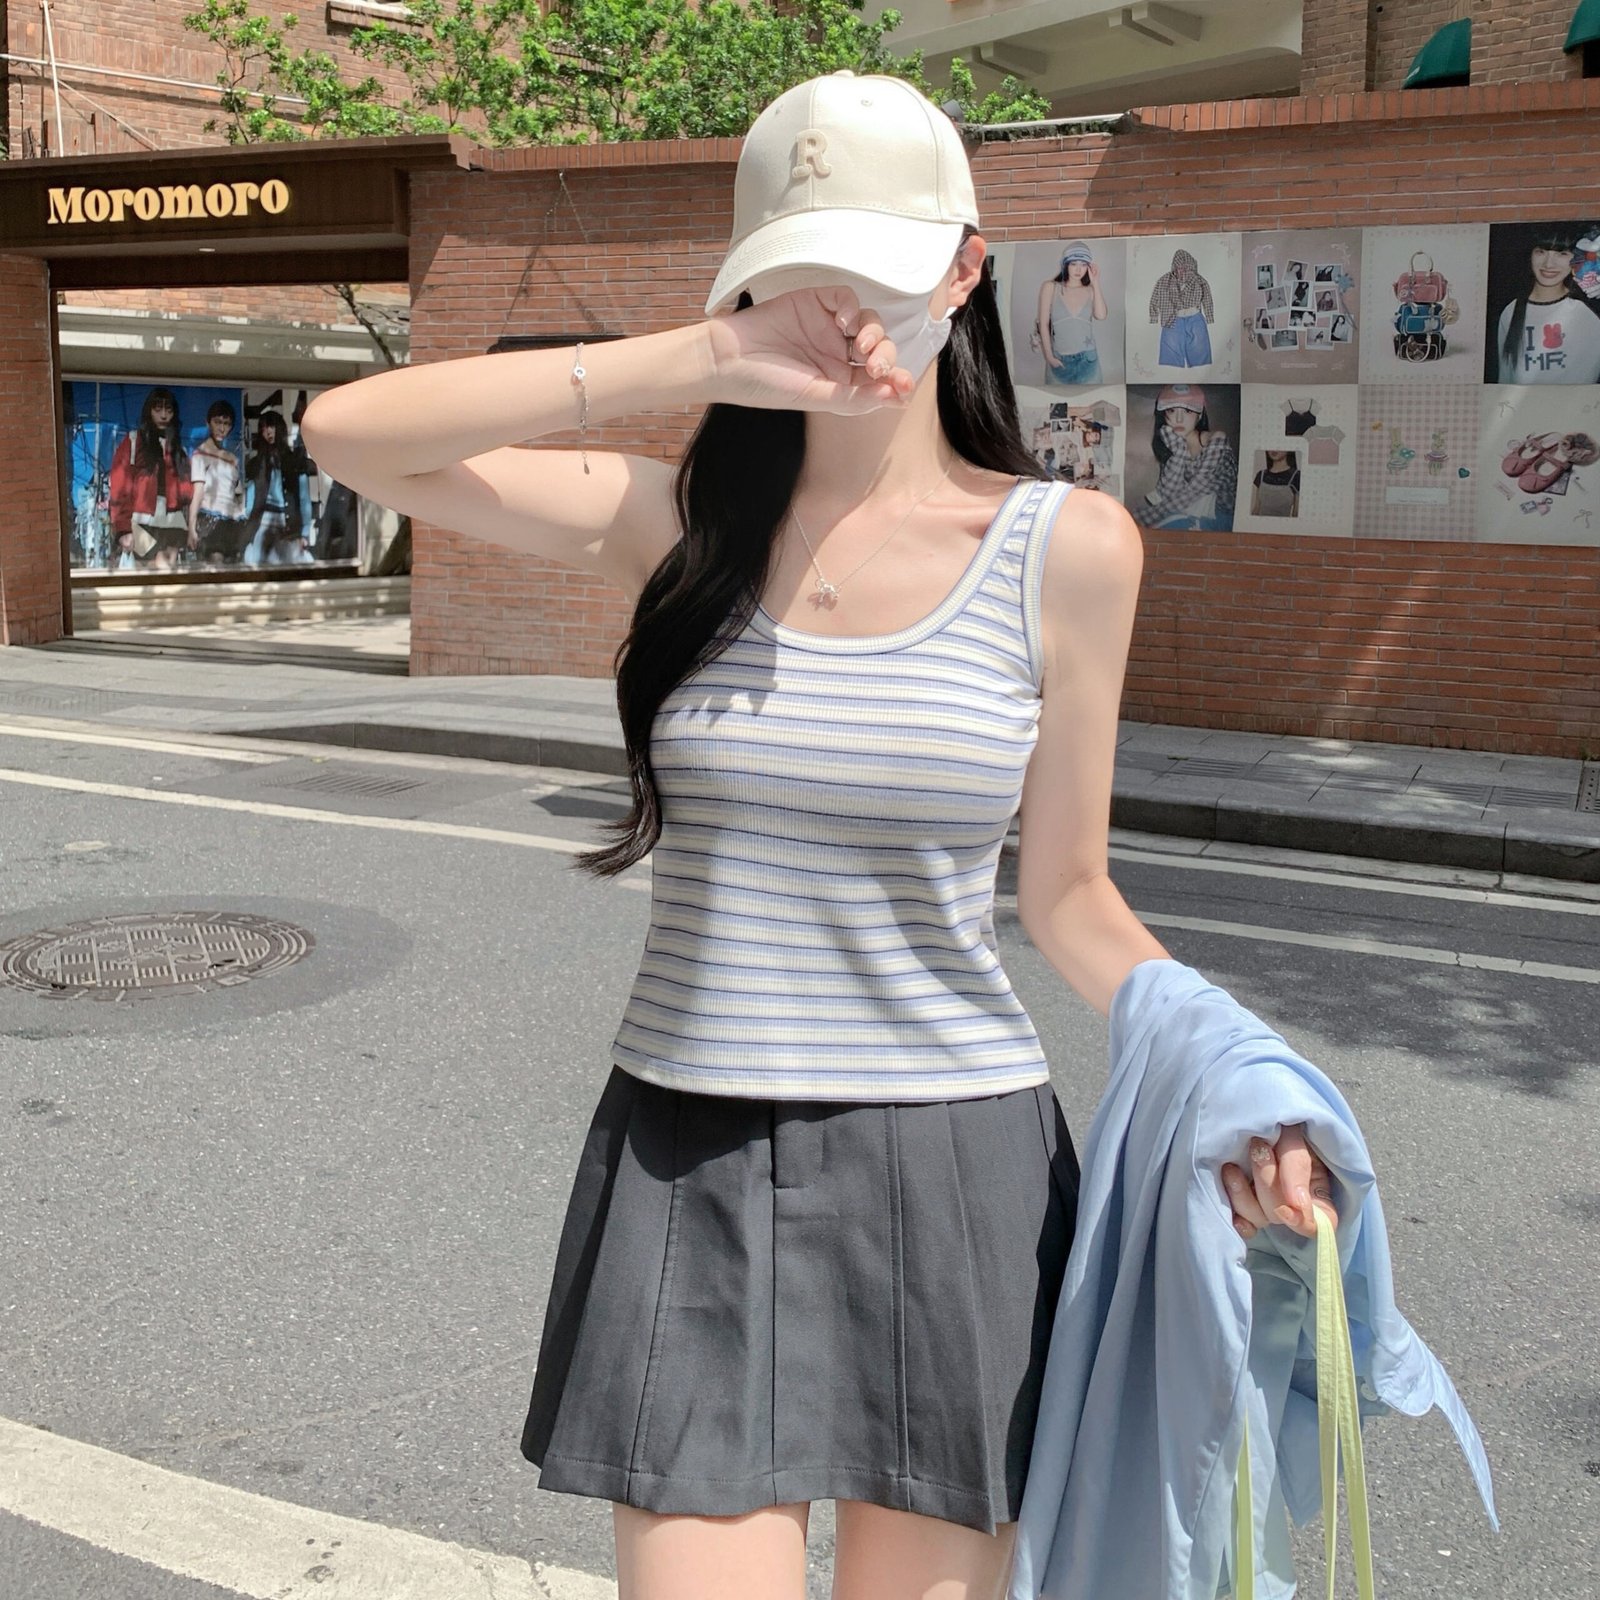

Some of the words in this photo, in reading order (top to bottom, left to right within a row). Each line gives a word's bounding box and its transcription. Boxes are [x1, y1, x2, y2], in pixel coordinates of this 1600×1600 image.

[792, 129, 832, 179] R
[48, 179, 290, 224] Moromoro
[1525, 326, 1535, 351] I
[1525, 351, 1567, 371] MR
